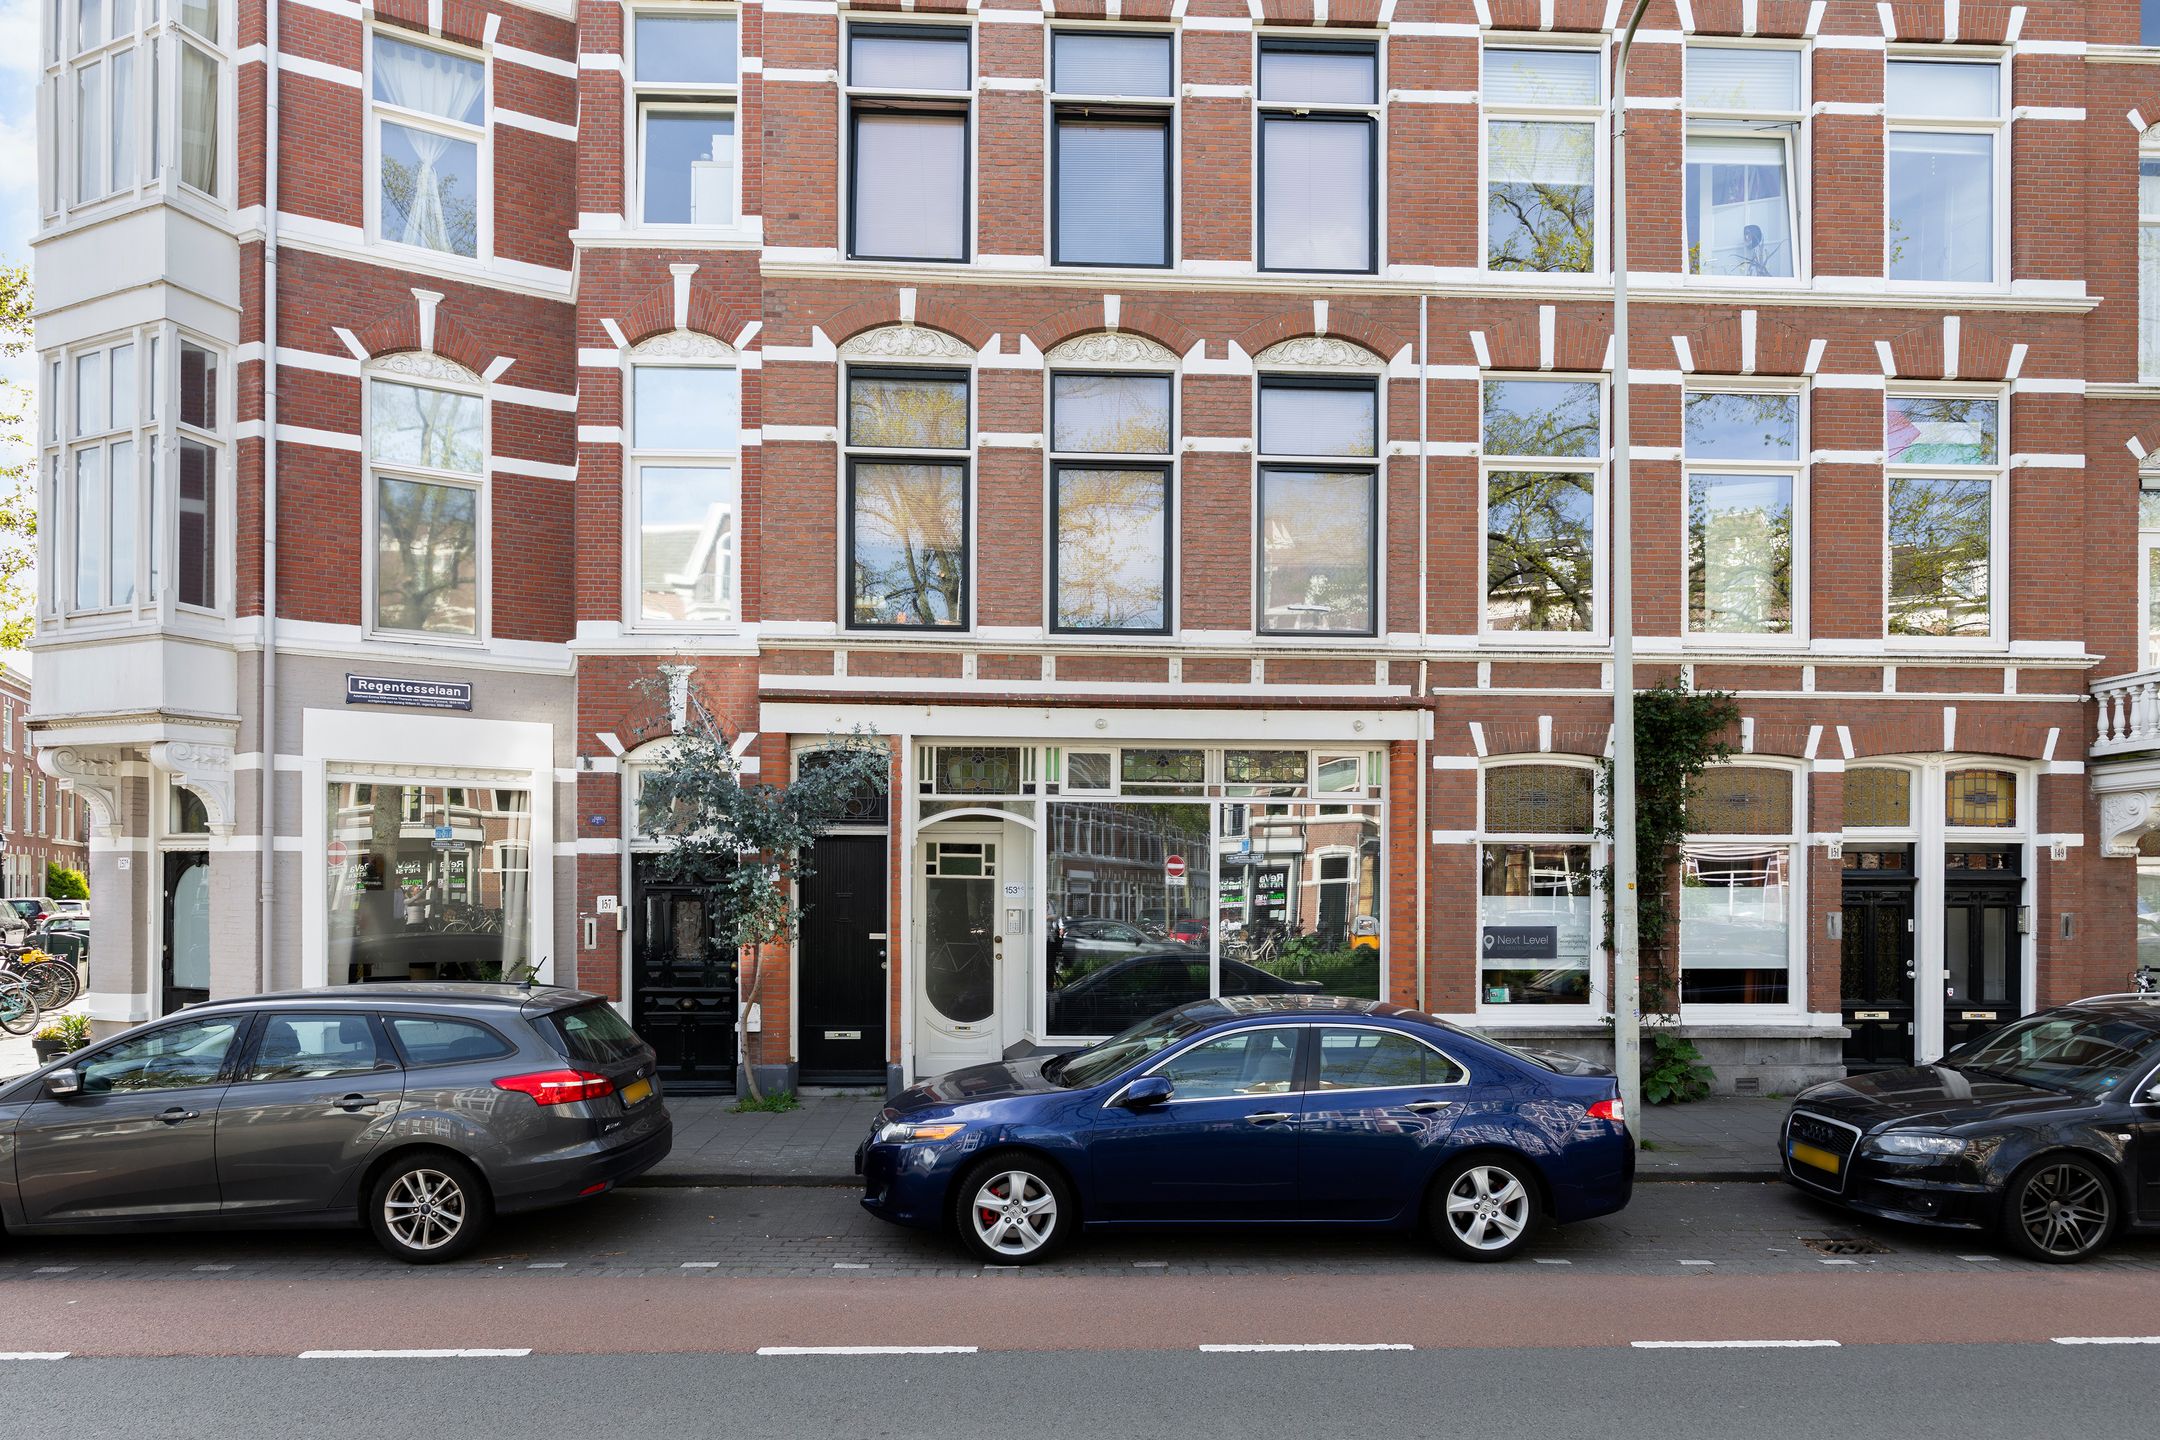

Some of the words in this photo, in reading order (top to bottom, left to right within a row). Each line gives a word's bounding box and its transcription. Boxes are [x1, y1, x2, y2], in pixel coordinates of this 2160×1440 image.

[358, 680, 461, 696] Regentesselaan
[2053, 848, 2065, 858] 149
[601, 898, 612, 909] 157
[1497, 935, 1520, 945] Next
[1523, 935, 1549, 945] Level
